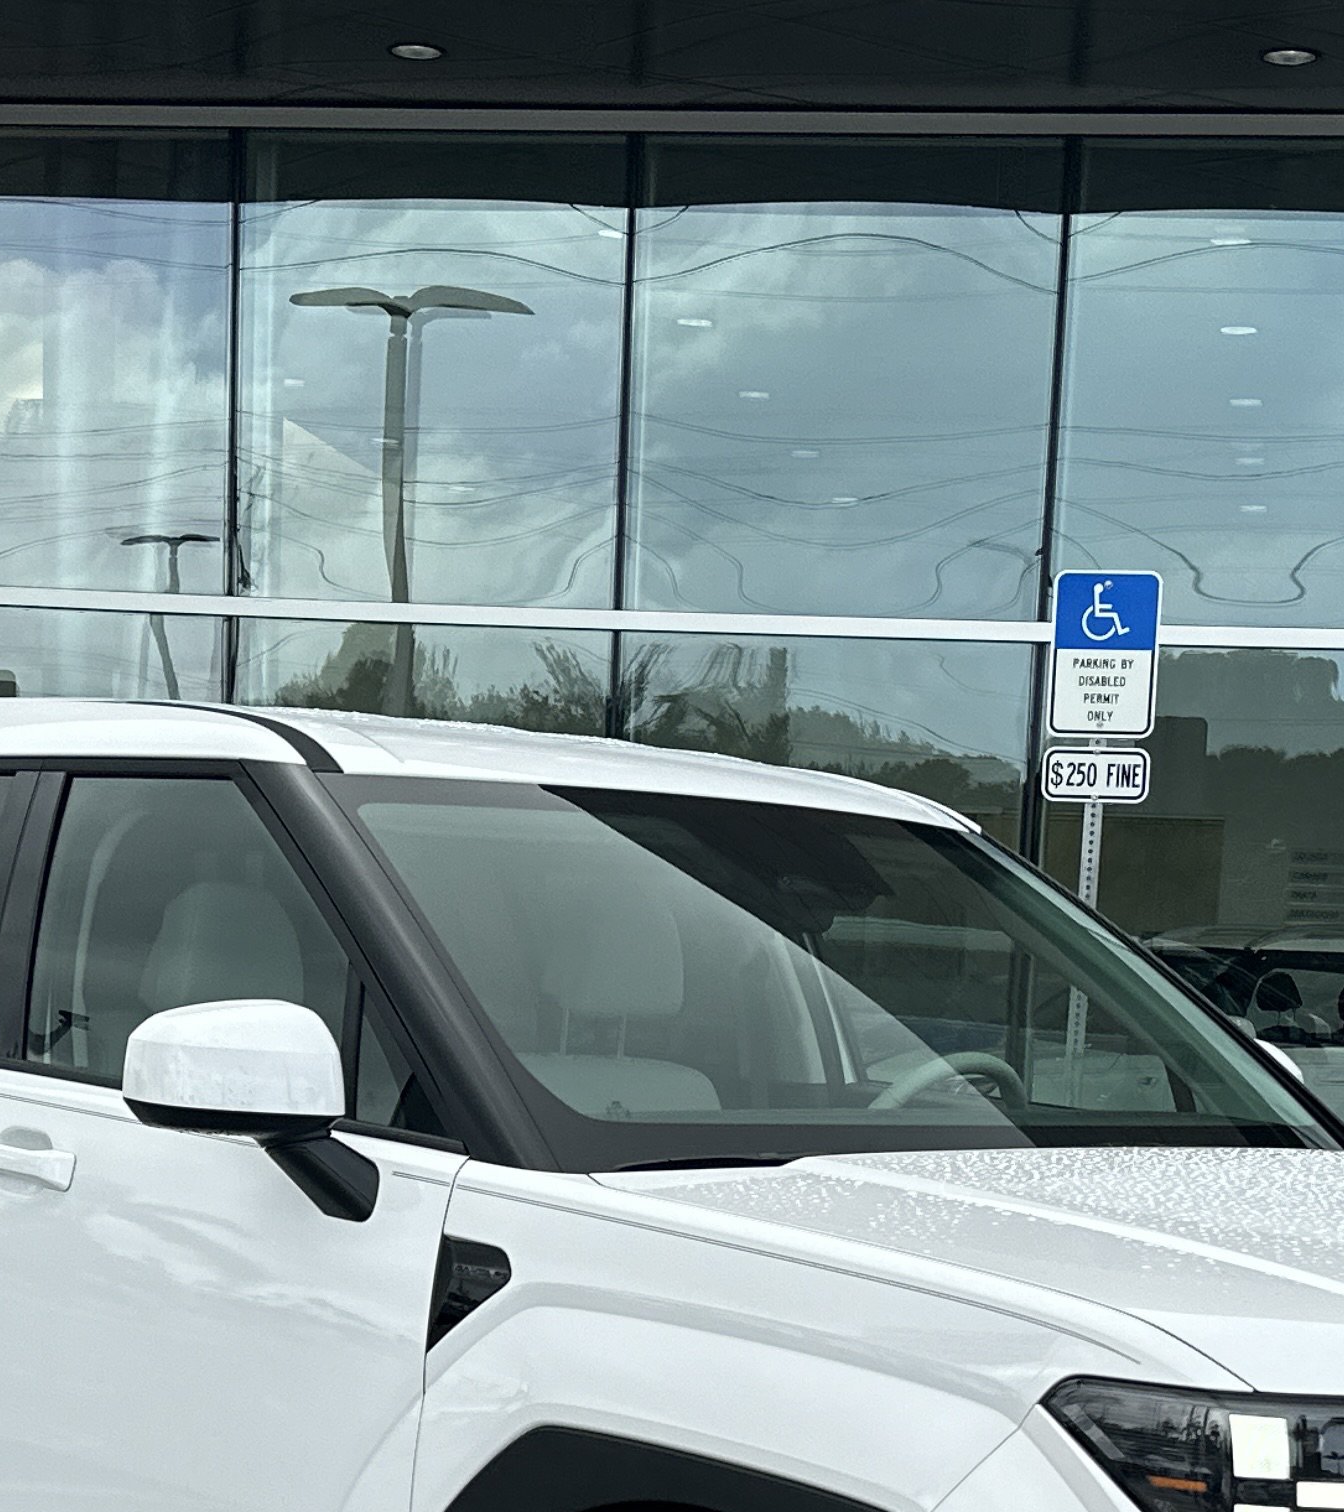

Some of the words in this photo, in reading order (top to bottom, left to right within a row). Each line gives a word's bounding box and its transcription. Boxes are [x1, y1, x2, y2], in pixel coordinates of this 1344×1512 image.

[1073, 658, 1116, 669] PARKING
[1121, 659, 1134, 669] BY
[1078, 676, 1126, 687] DISABLED
[1083, 693, 1120, 704] PERMIT
[1087, 711, 1114, 722] ONLY
[1050, 760, 1098, 788] $250
[1106, 763, 1141, 788] FINE
